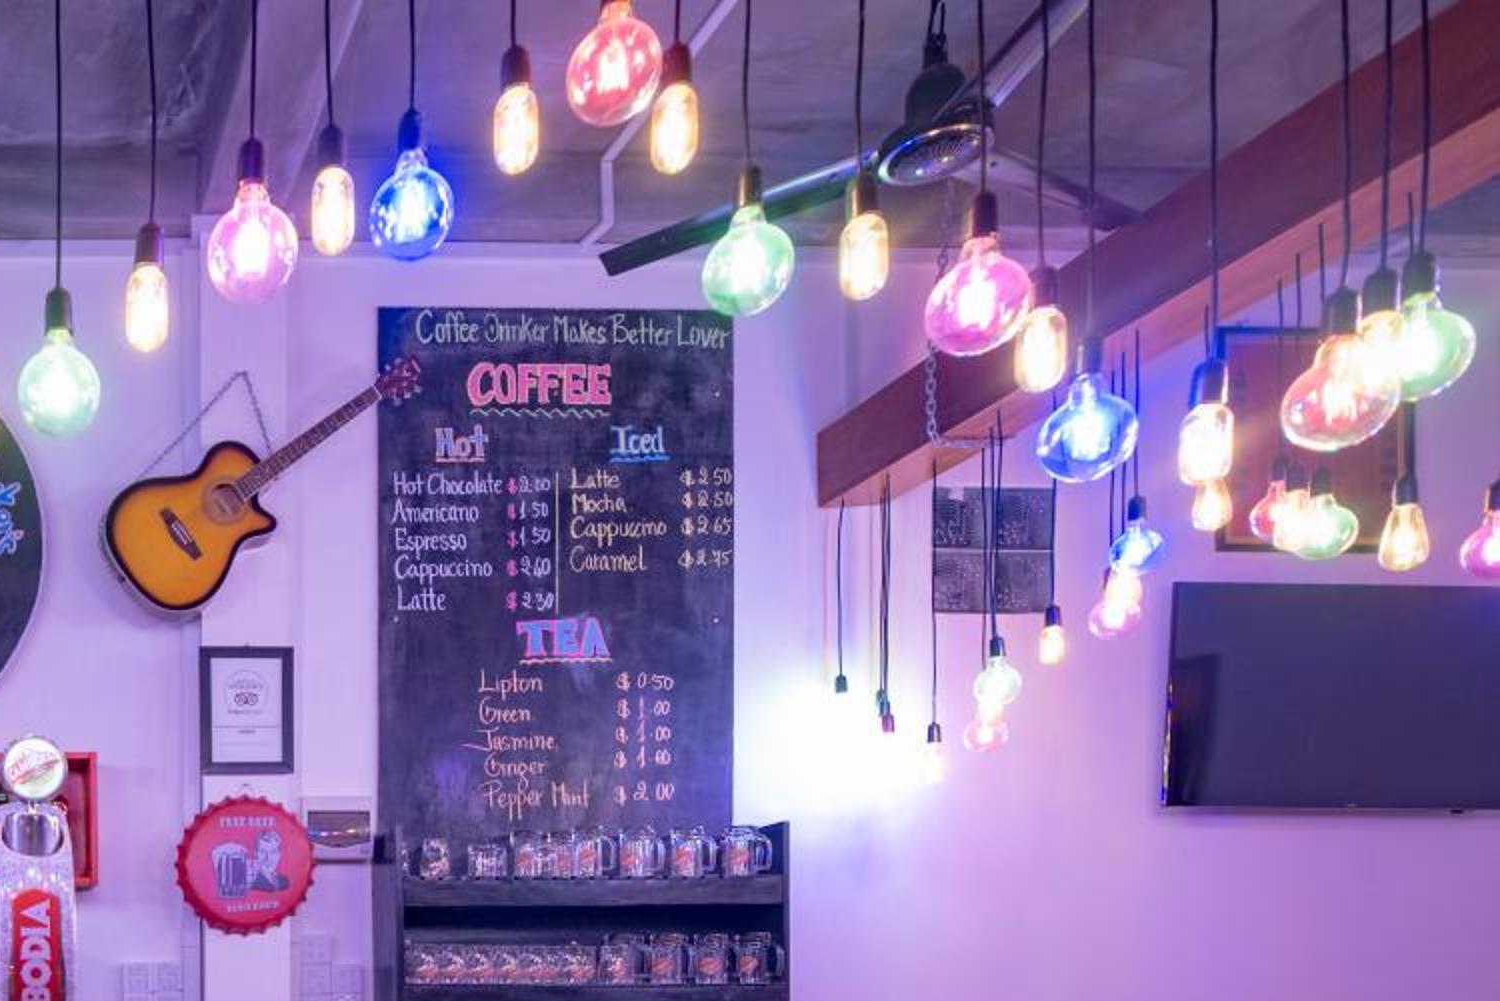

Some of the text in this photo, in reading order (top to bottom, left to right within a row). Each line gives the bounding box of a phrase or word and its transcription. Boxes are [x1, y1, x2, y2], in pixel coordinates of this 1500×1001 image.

[416, 309, 479, 345] Coffee
[552, 315, 606, 345] Makes
[608, 313, 673, 345] Better
[676, 315, 730, 351] Lover
[465, 361, 613, 407] COFFEE
[435, 424, 488, 458] Hot
[610, 425, 667, 456] Iced
[392, 471, 424, 496] Hot
[427, 469, 503, 496] Chocolate
[570, 467, 622, 489] Latte
[390, 498, 479, 525] Americano
[570, 492, 627, 515] Mocha
[394, 527, 468, 561] Espresso
[570, 545, 648, 573] Caramel
[397, 583, 447, 612] Latte
[515, 617, 611, 658] TEA
[477, 668, 544, 701] Lipton
[479, 694, 534, 725] Green
[466, 726, 558, 752] Jasmine
[483, 752, 548, 790] Ginger
